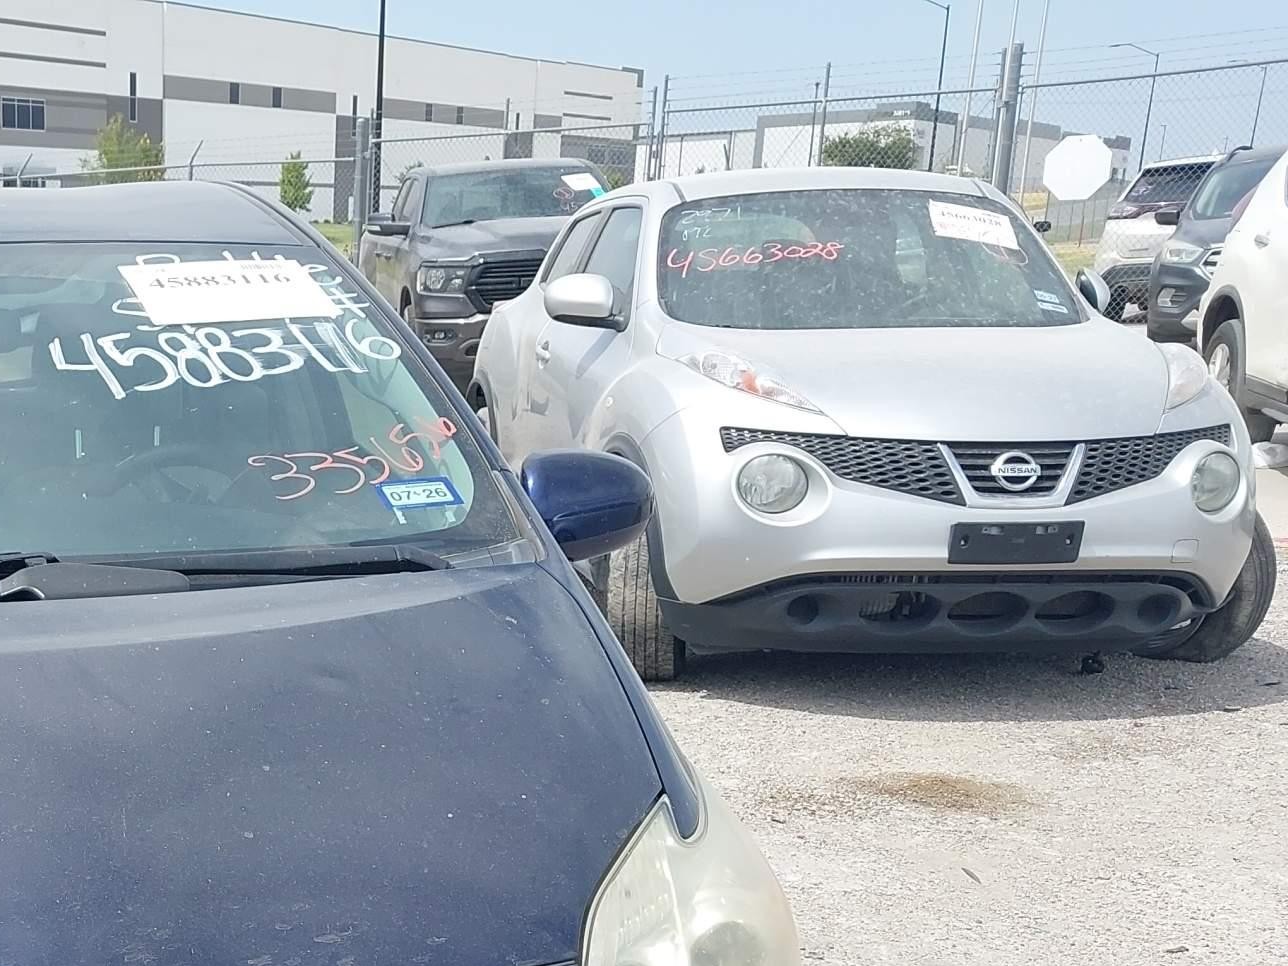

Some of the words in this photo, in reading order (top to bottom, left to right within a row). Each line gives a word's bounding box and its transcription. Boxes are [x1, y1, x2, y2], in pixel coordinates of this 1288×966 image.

[667, 241, 845, 279] 45663028
[149, 272, 292, 290] 45883116
[47, 318, 403, 400] 45883116
